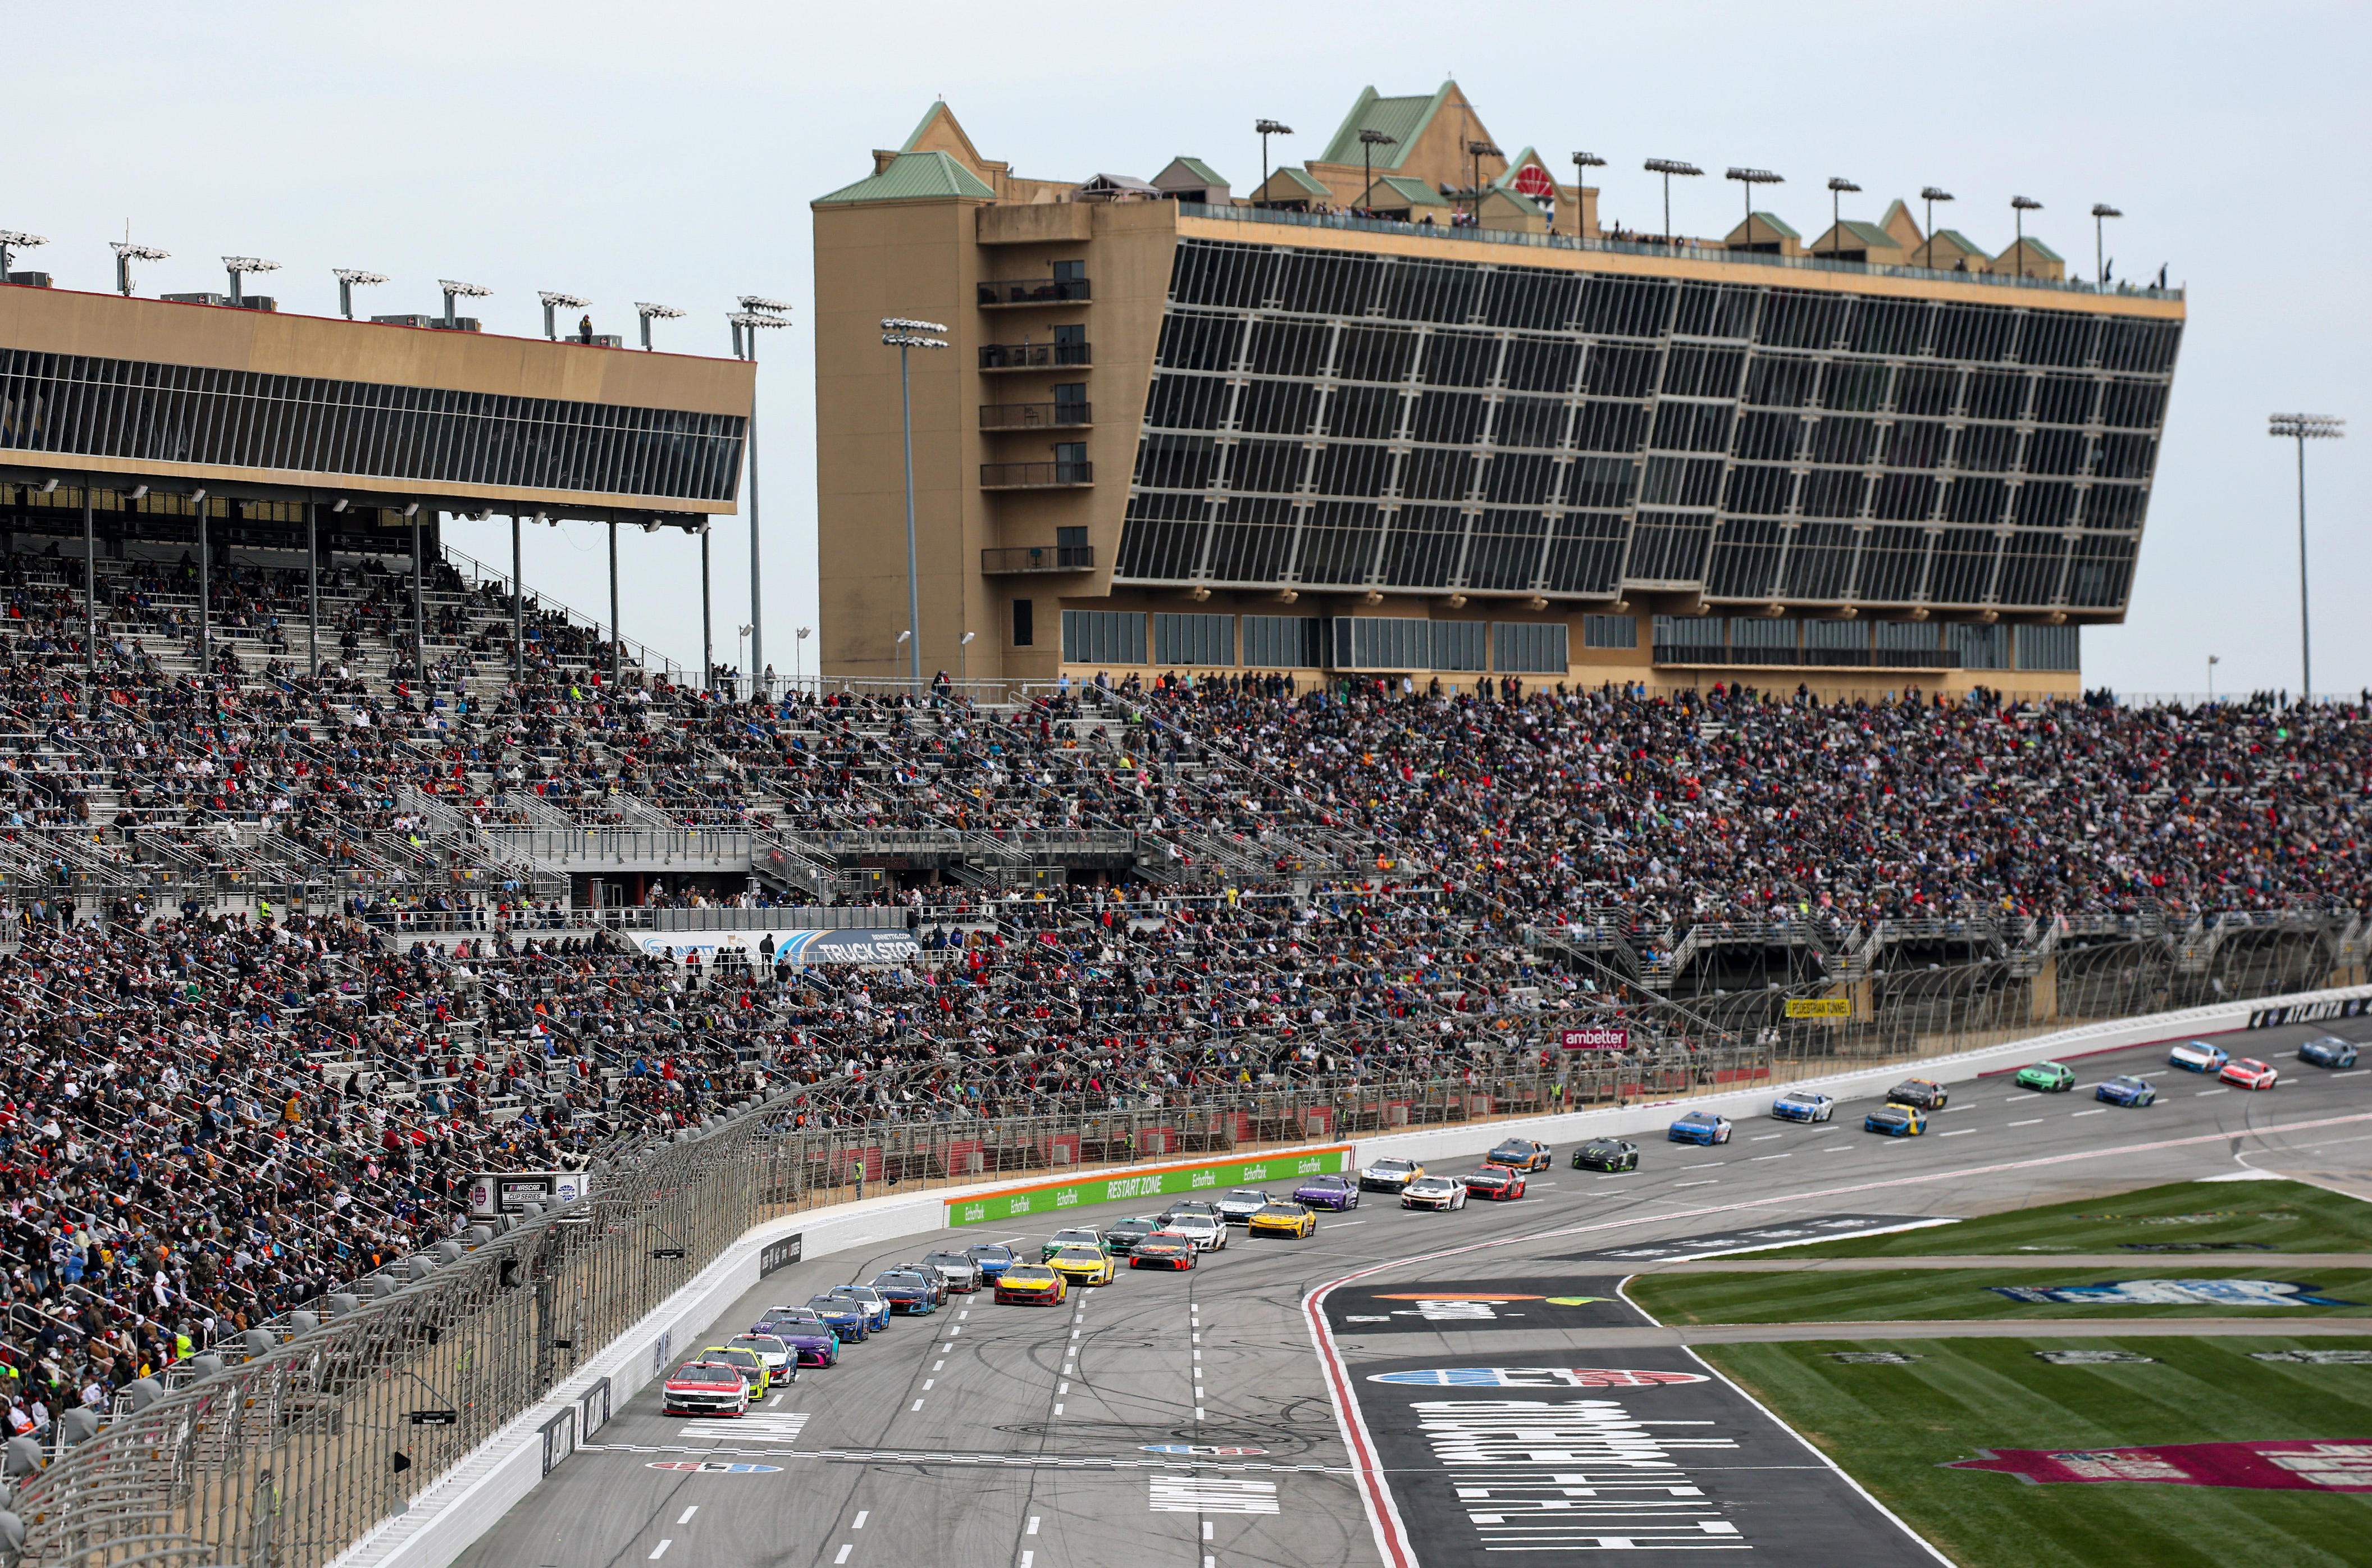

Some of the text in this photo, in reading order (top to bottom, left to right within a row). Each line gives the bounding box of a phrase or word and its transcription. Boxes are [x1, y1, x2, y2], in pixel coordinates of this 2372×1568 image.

[650, 945, 715, 956] BNNETT
[818, 941, 920, 961] TRUCK STOP
[2283, 1001, 2343, 1024] ATLANTA
[1566, 1029, 1624, 1045] ambetter
[1243, 1164, 1267, 1181] EchoPark
[1298, 1157, 1321, 1174] EchoPark
[1107, 1175, 1162, 1200] RESTART ZONE
[1192, 1170, 1216, 1187] EchoPark
[1011, 1196, 1029, 1214] EchoPark
[1057, 1188, 1078, 1206] EchoPark
[965, 1204, 984, 1221] EchoPark
[586, 1387, 605, 1439] ATLANTA
[550, 1413, 572, 1470] ATLANTA
[1409, 1400, 1740, 1467] ambetter
[1149, 1475, 1280, 1514] ATLANTA
[1448, 1473, 1754, 1551] HEALTH
